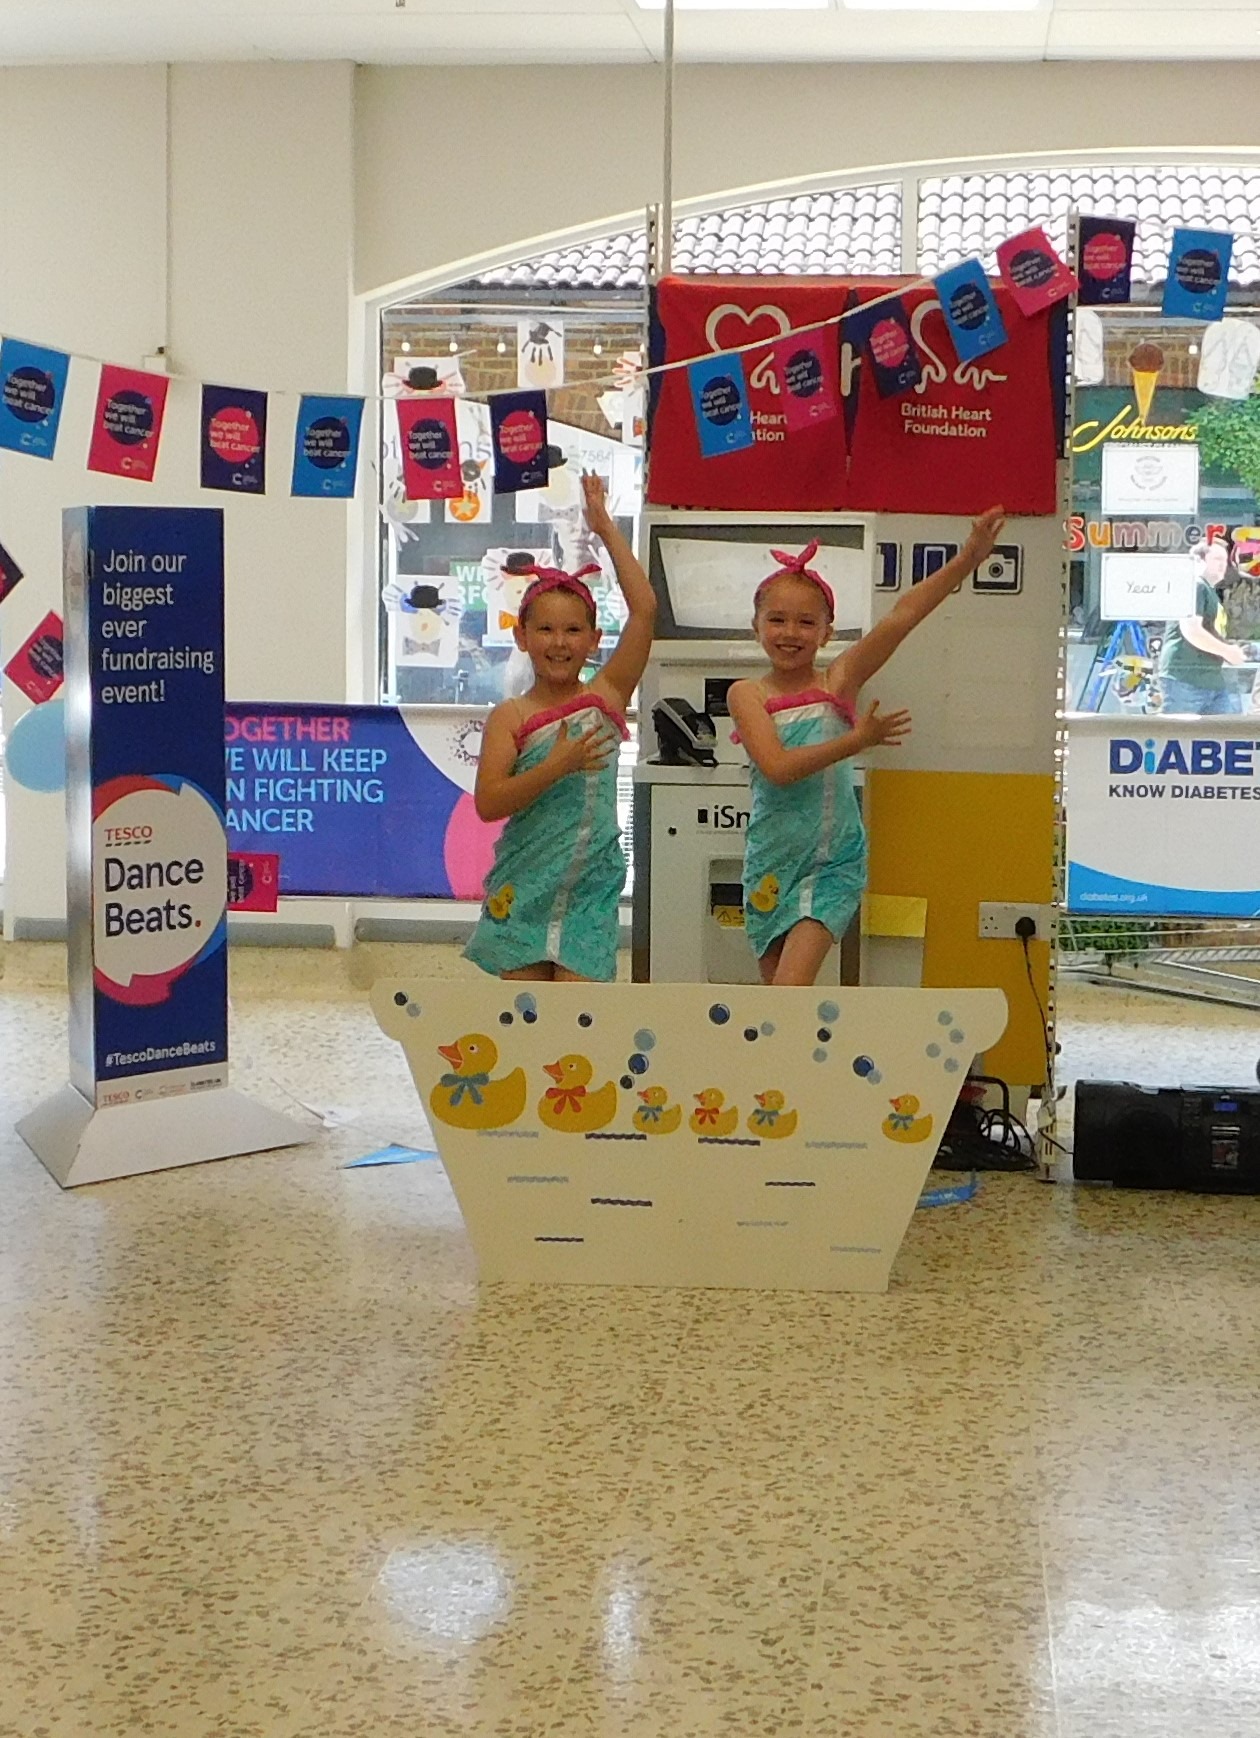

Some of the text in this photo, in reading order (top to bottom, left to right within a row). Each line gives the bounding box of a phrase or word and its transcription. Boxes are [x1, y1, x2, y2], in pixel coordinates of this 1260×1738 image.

[749, 409, 788, 425] Hear
[901, 402, 992, 421] British Heart
[904, 419, 987, 437] Foundation
[1072, 404, 1198, 452] Johnsons
[1063, 516, 1226, 552] Summer
[103, 549, 187, 573] Join our
[103, 582, 174, 611] biggest
[1126, 580, 1157, 594] Year
[101, 619, 147, 639] ever
[101, 646, 214, 674] fundraising
[101, 679, 165, 704] event!
[225, 716, 350, 743] OGETHER
[226, 747, 388, 773] E WILL KEEP
[1109, 738, 1260, 776] DiABE
[226, 778, 384, 803] N FIGHTING
[1109, 784, 1260, 800] KNOW DIABETES
[226, 808, 314, 832] ANCER
[104, 825, 153, 841] TESCO
[104, 857, 204, 893] Dance
[105, 898, 202, 937] Beats.
[105, 1040, 216, 1067] #TescoDanceBeats
